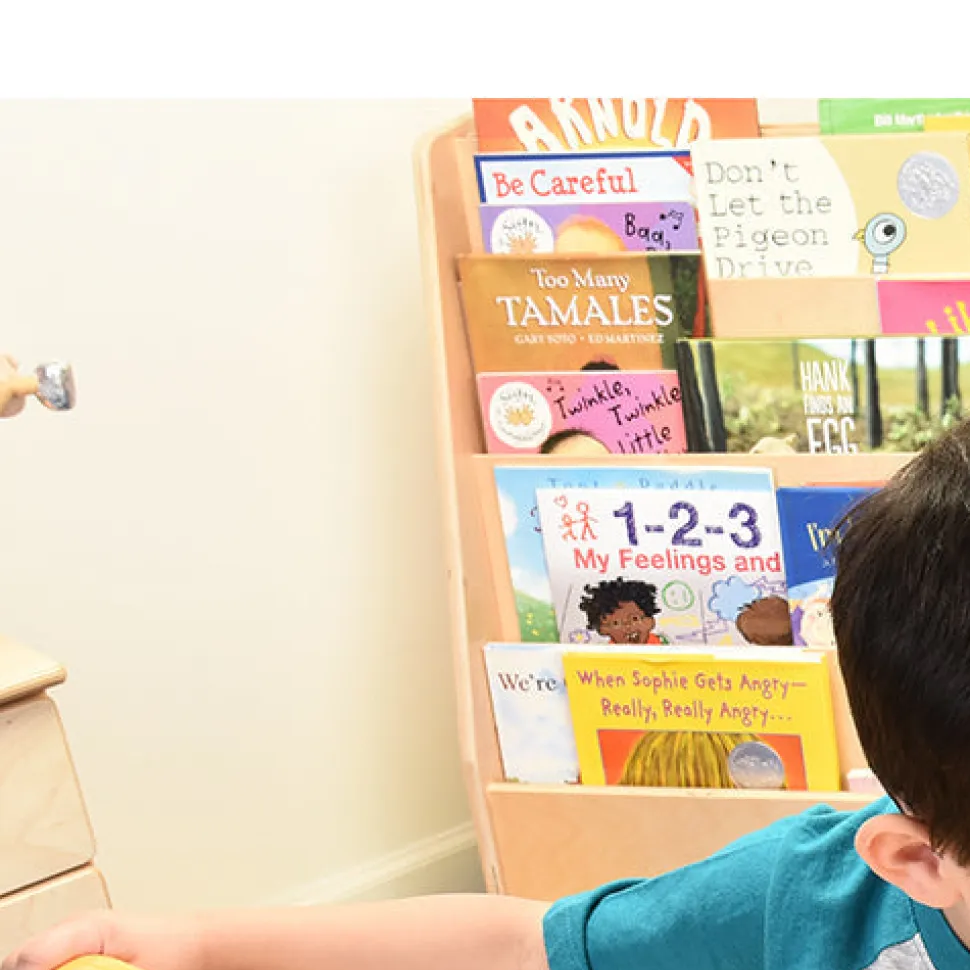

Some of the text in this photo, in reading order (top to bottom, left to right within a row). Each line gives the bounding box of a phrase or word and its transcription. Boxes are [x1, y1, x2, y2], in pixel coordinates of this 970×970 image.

[508, 98, 711, 151] ARNOLD
[491, 166, 638, 198] Be Careful
[705, 157, 800, 184] Don't
[708, 189, 832, 217] Let the
[713, 223, 829, 252] Pigeon
[530, 266, 630, 292] Too Many
[715, 253, 813, 278] Drive
[496, 294, 674, 327] TAMALES
[800, 359, 851, 393] HANK
[553, 380, 632, 421] Twinkle,
[608, 385, 682, 427] Twinkle
[806, 416, 858, 455] EGG
[612, 500, 763, 550] 1-2-3
[573, 548, 781, 575] My Feelings and
[498, 671, 557, 692] We're
[576, 670, 626, 688] When
[632, 670, 689, 694] Sophie
[694, 671, 732, 691] Gets
[600, 697, 658, 722] Really,
[663, 699, 713, 724] Really
